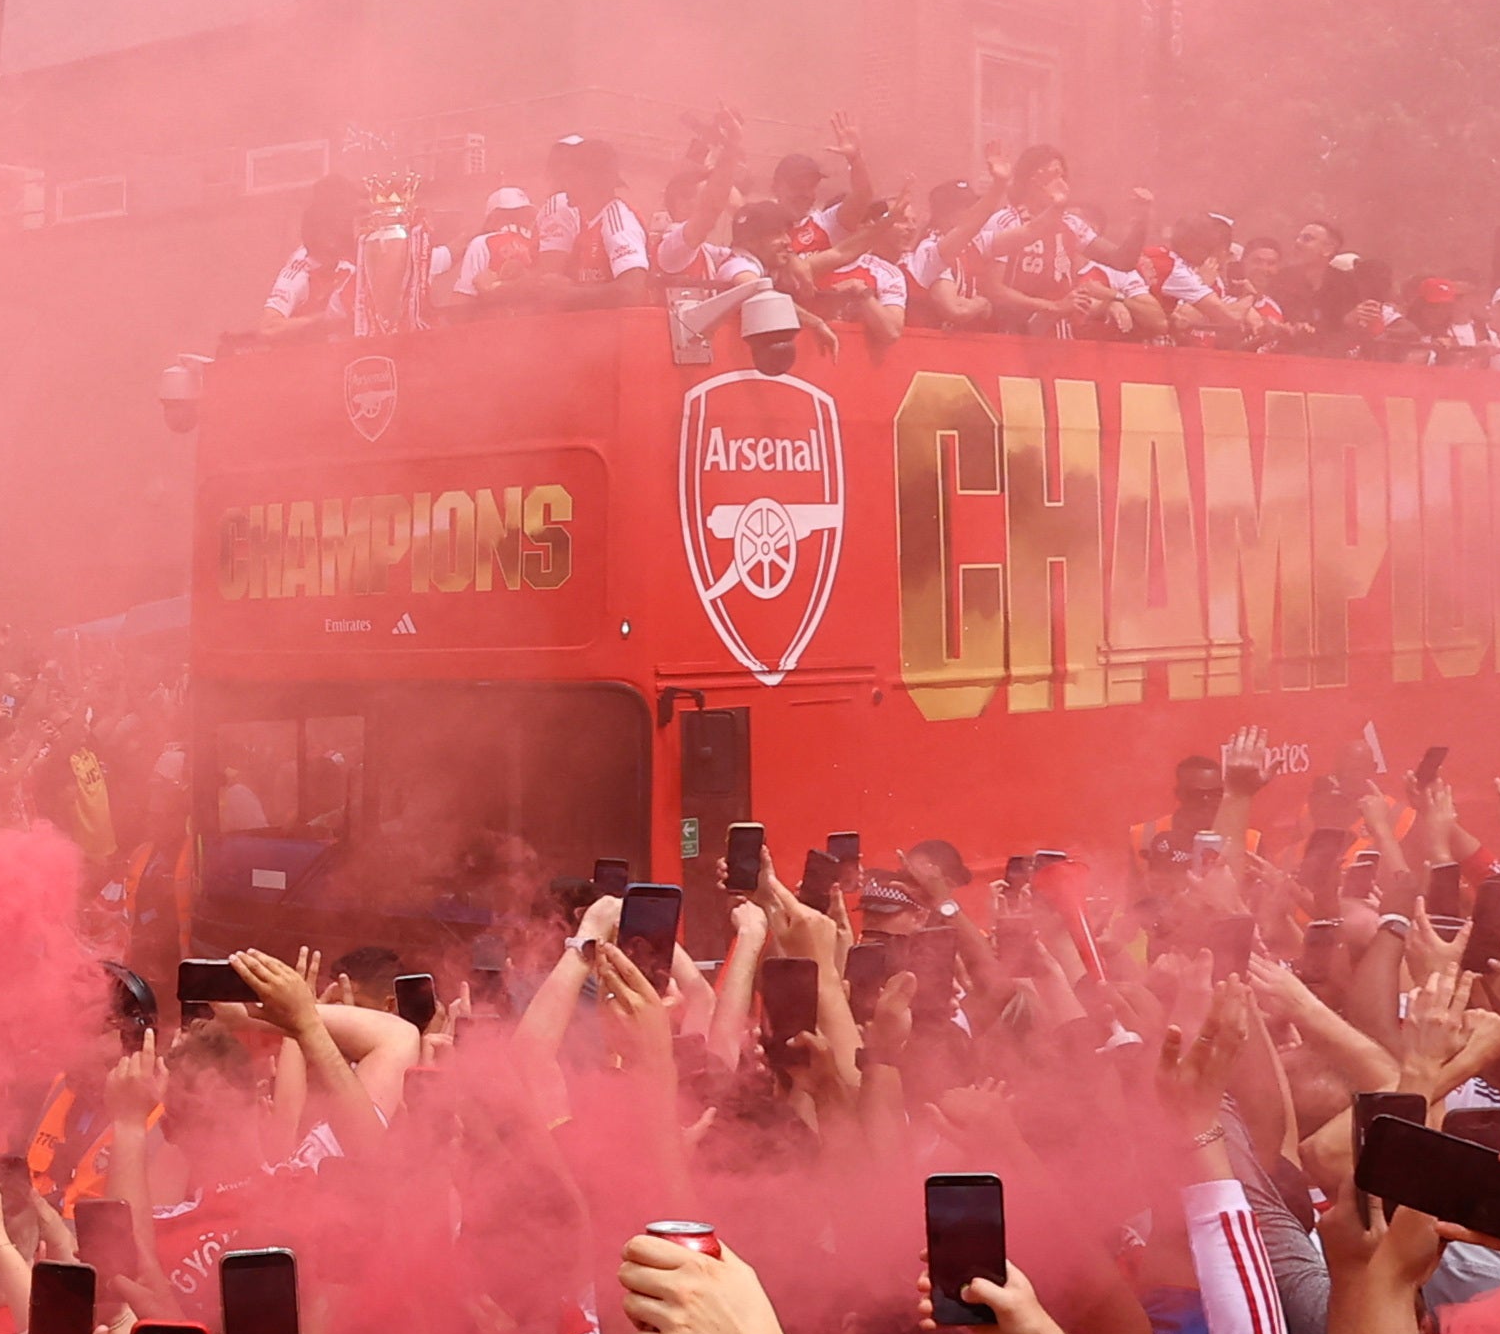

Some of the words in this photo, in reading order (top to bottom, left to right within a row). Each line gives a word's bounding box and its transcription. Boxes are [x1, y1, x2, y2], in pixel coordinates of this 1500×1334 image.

[703, 426, 821, 472] Arsenal
[216, 484, 573, 601] CHAMPIONS
[324, 618, 372, 634] Emirates
